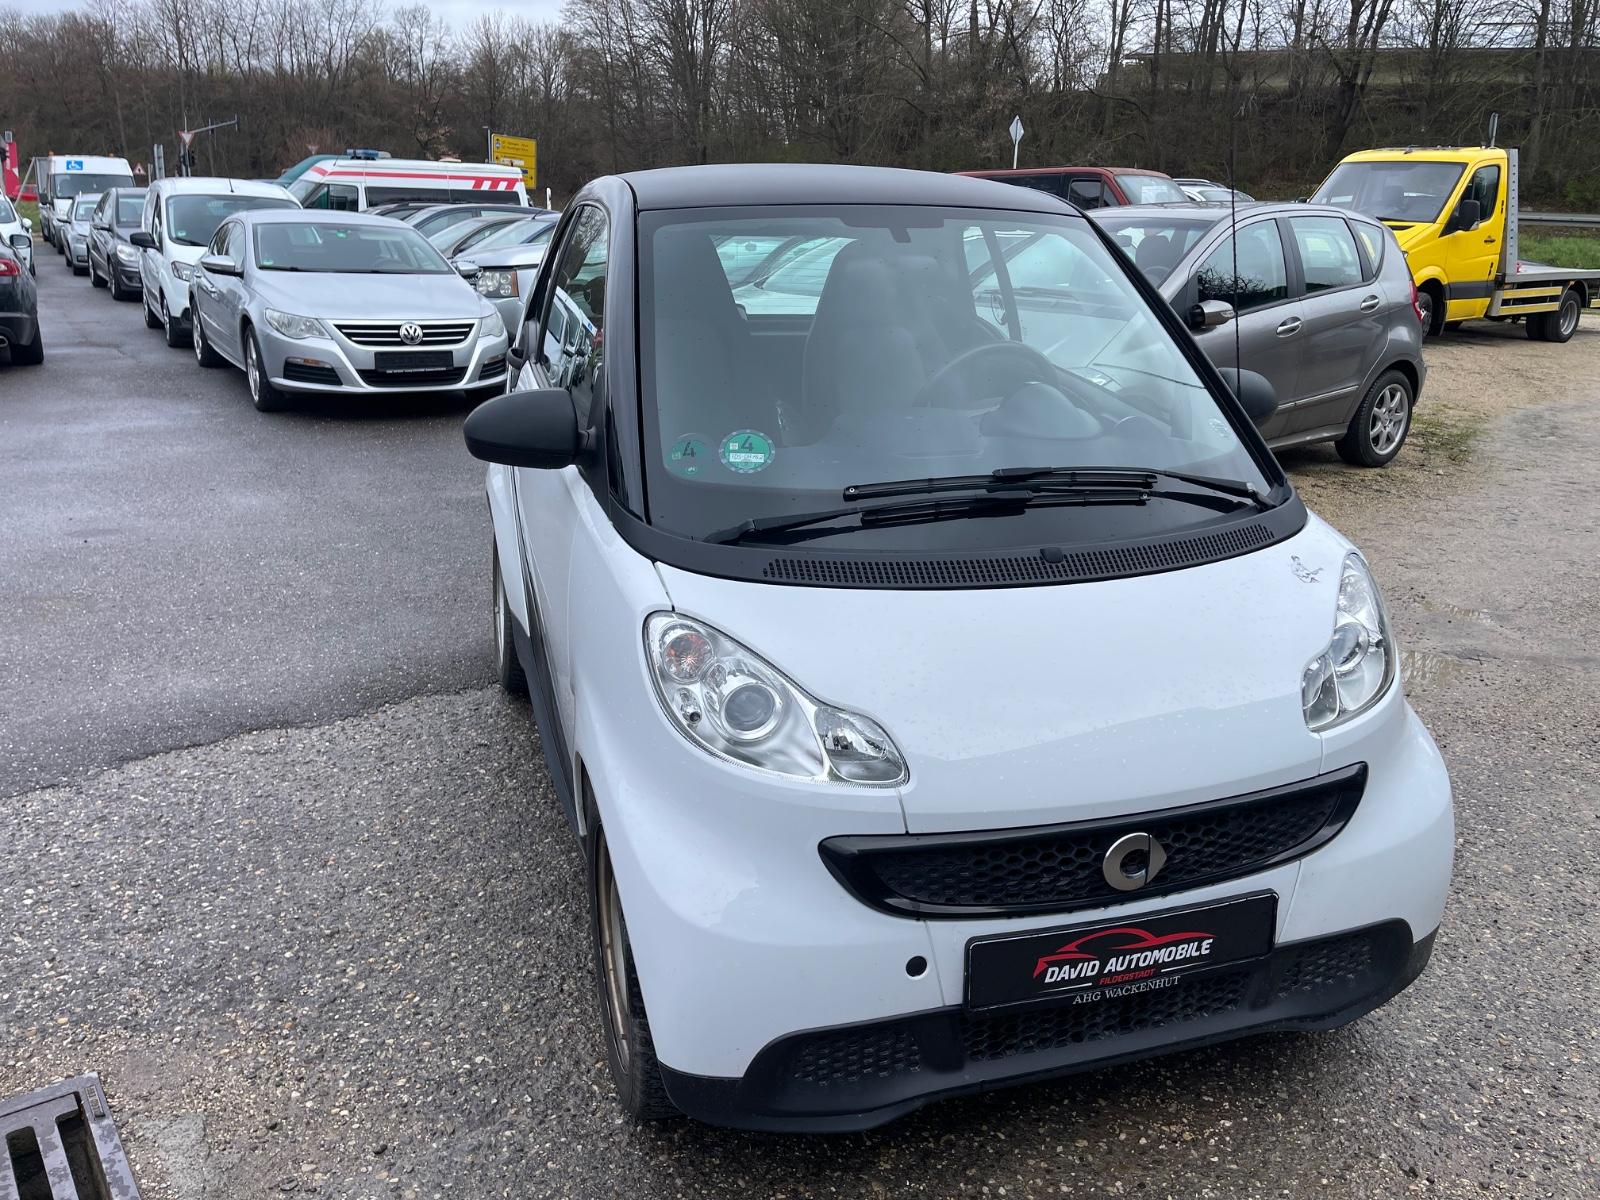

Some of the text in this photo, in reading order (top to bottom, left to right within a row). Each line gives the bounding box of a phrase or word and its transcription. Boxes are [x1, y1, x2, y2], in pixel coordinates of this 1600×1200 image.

[400, 323, 423, 345] VW
[682, 440, 696, 457] 4
[741, 435, 754, 452] 4
[1044, 939, 1214, 983] DAVID AUTOMOBILE
[1099, 968, 1156, 985] FILDERSTADT
[1072, 976, 1181, 1004] AHG WACKENHUT
